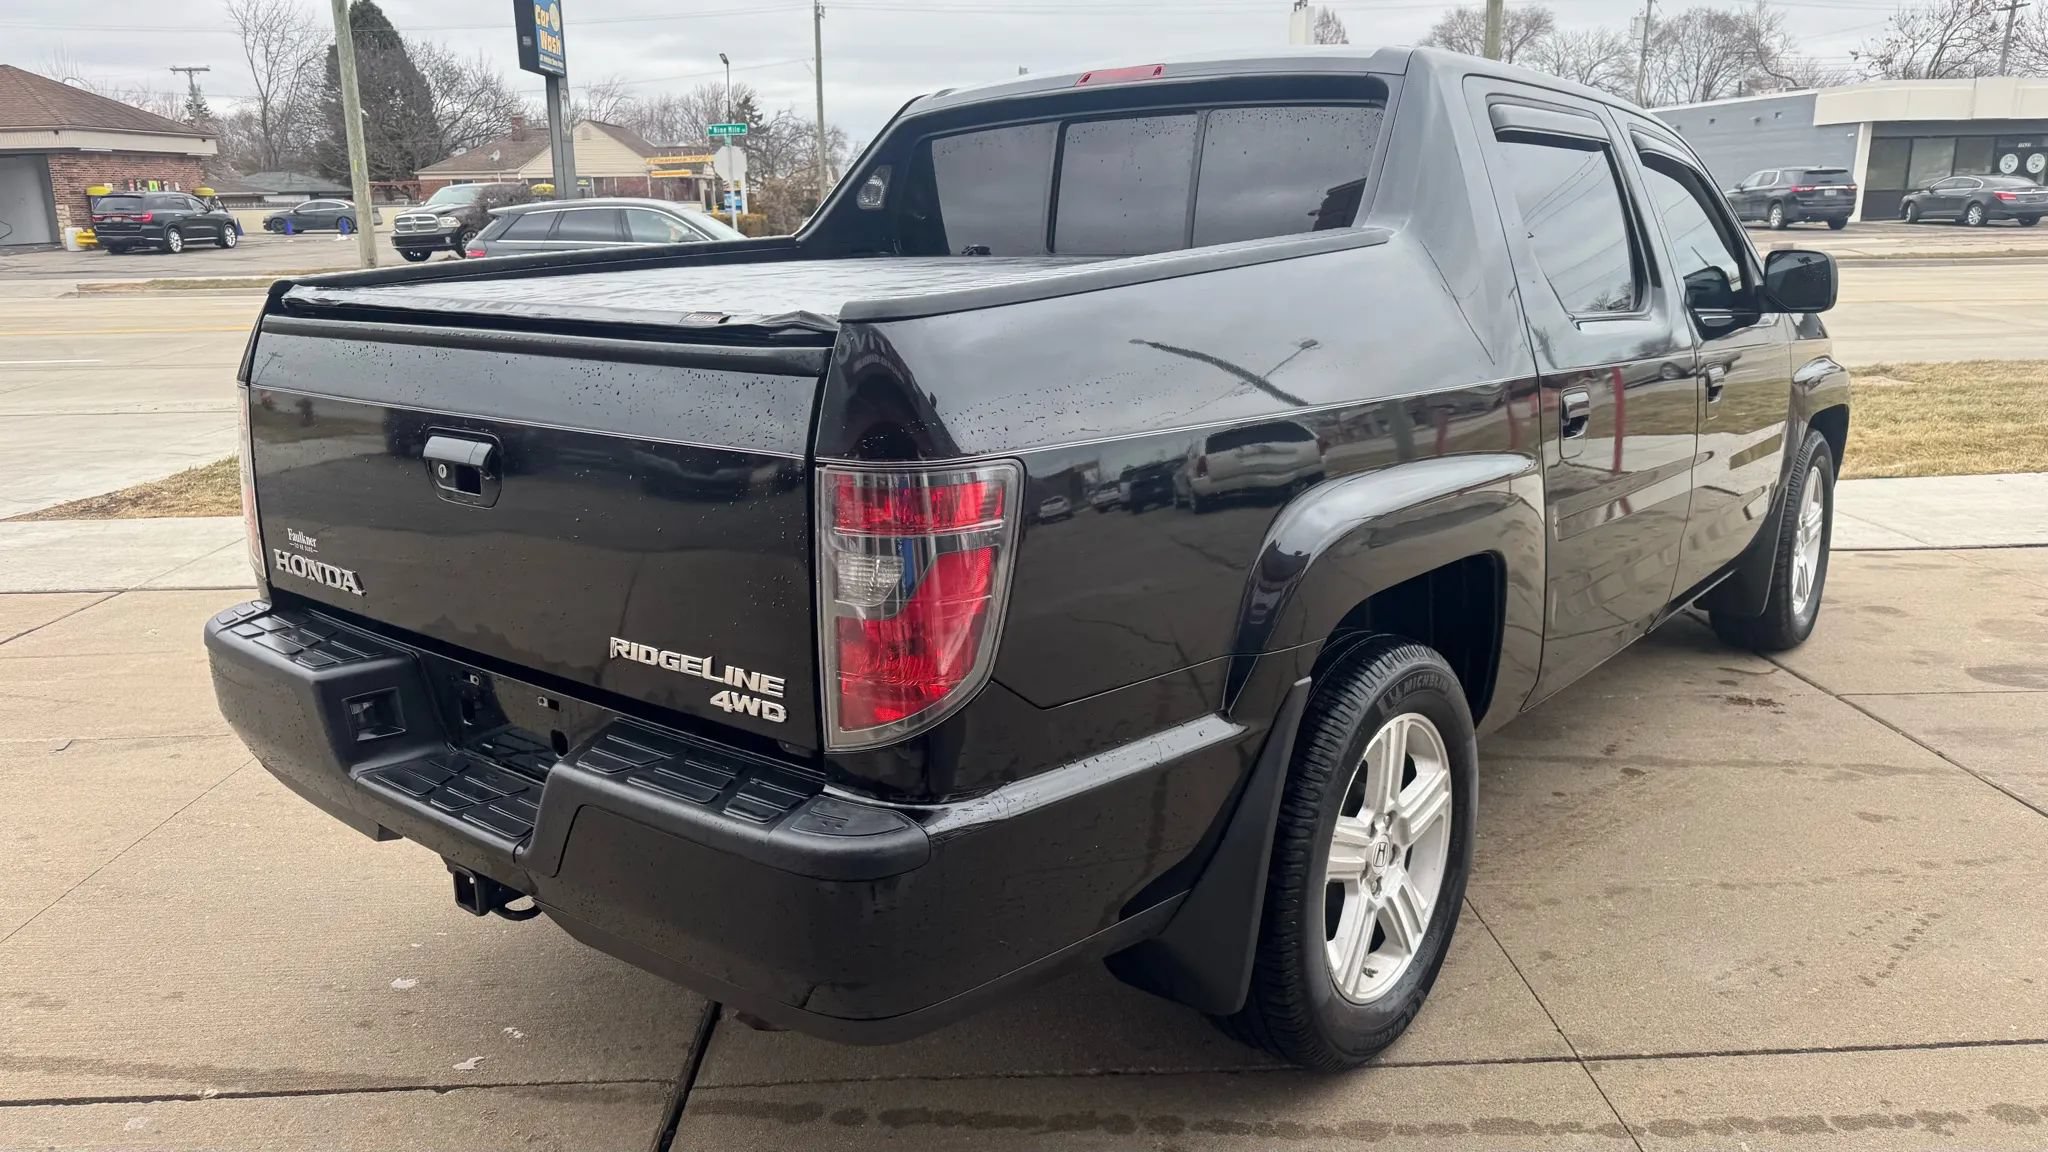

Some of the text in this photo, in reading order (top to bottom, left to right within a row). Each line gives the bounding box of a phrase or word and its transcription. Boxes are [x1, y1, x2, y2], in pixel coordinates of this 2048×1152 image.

[535, 4, 550, 28] Car
[540, 29, 561, 56] Wash
[287, 528, 317, 548] Faulkner
[273, 548, 366, 596] HONDA
[610, 636, 786, 698] RIDGELINE
[1403, 672, 1450, 696] MICHELIN
[709, 690, 787, 723] 4WD
